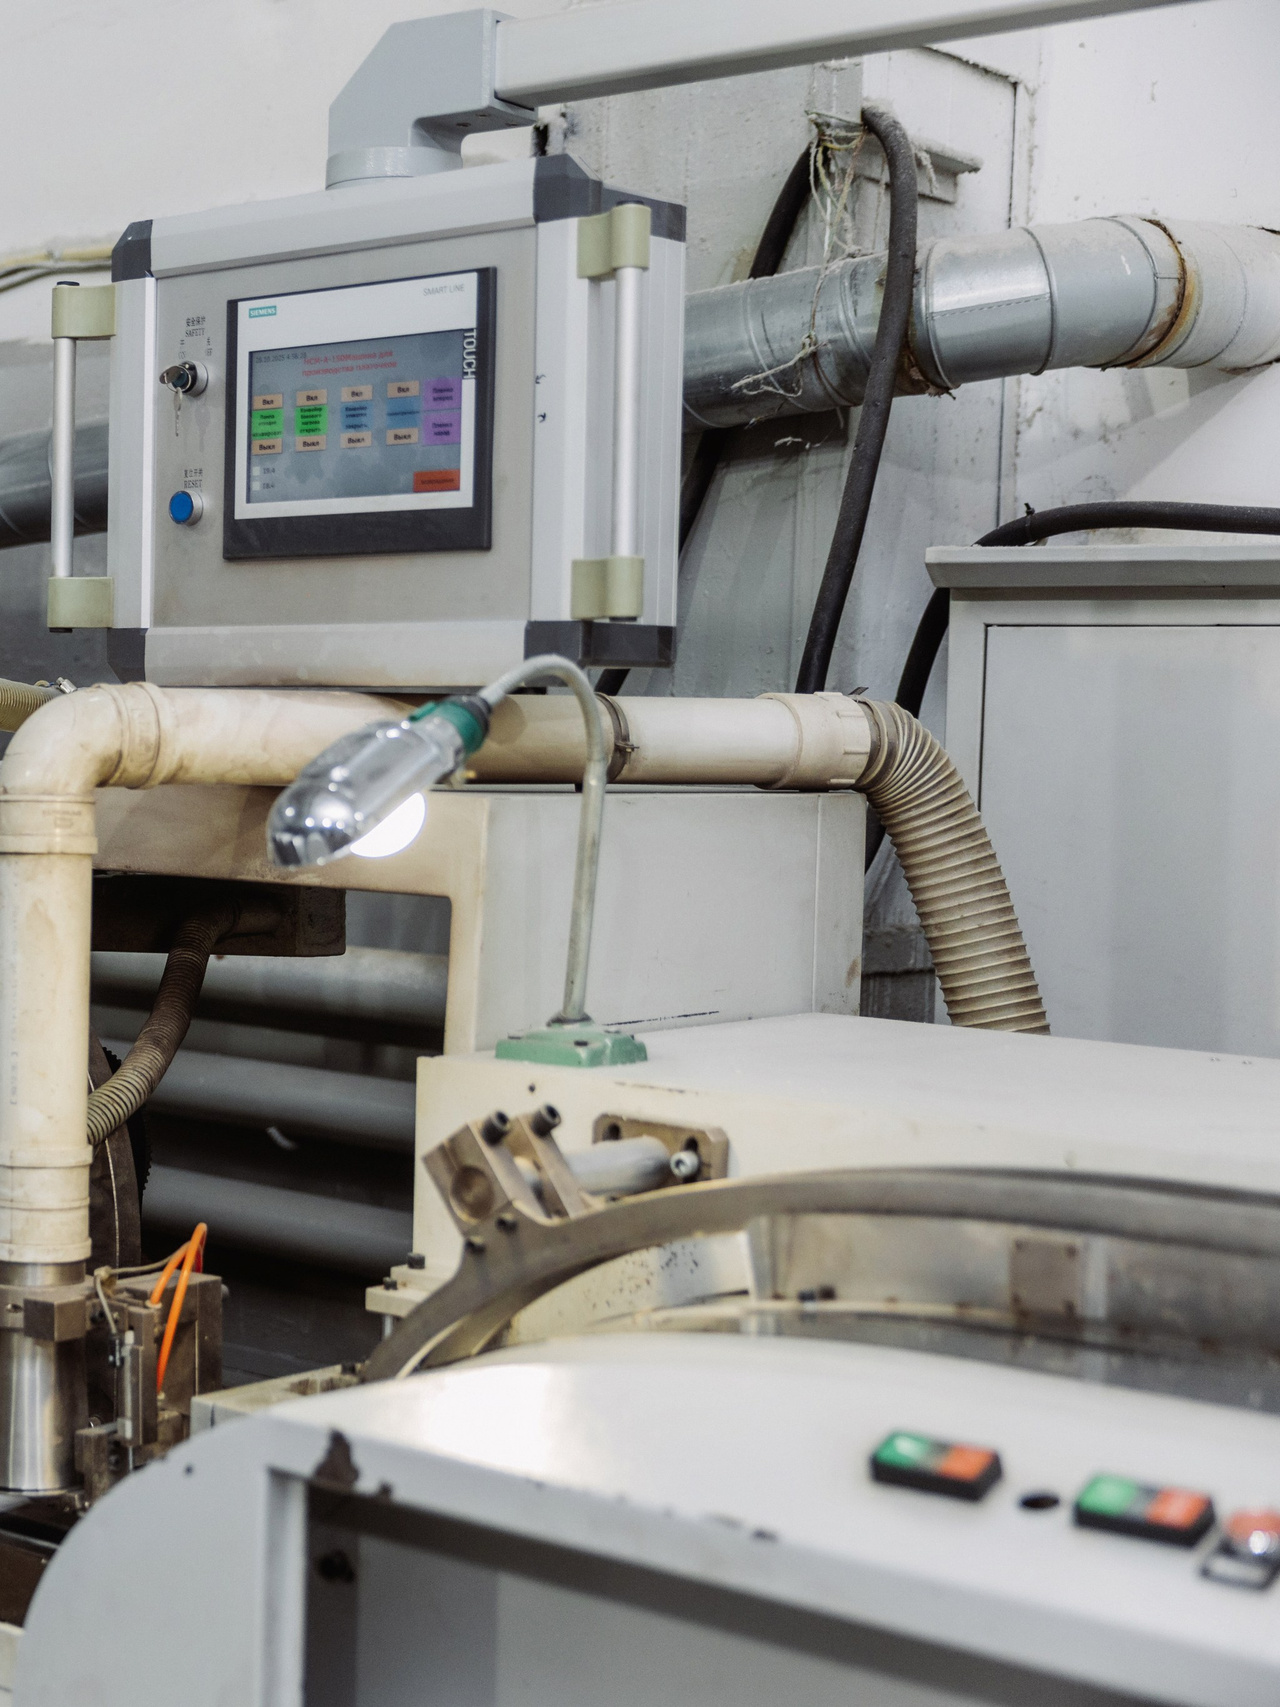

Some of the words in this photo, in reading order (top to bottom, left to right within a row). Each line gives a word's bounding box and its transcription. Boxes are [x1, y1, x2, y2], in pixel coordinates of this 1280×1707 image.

[423, 285, 447, 296] SMART
[449, 284, 465, 293] LINE
[250, 306, 276, 317] SIEMENS
[463, 329, 476, 379] TOUCH
[183, 479, 203, 489] RESET
